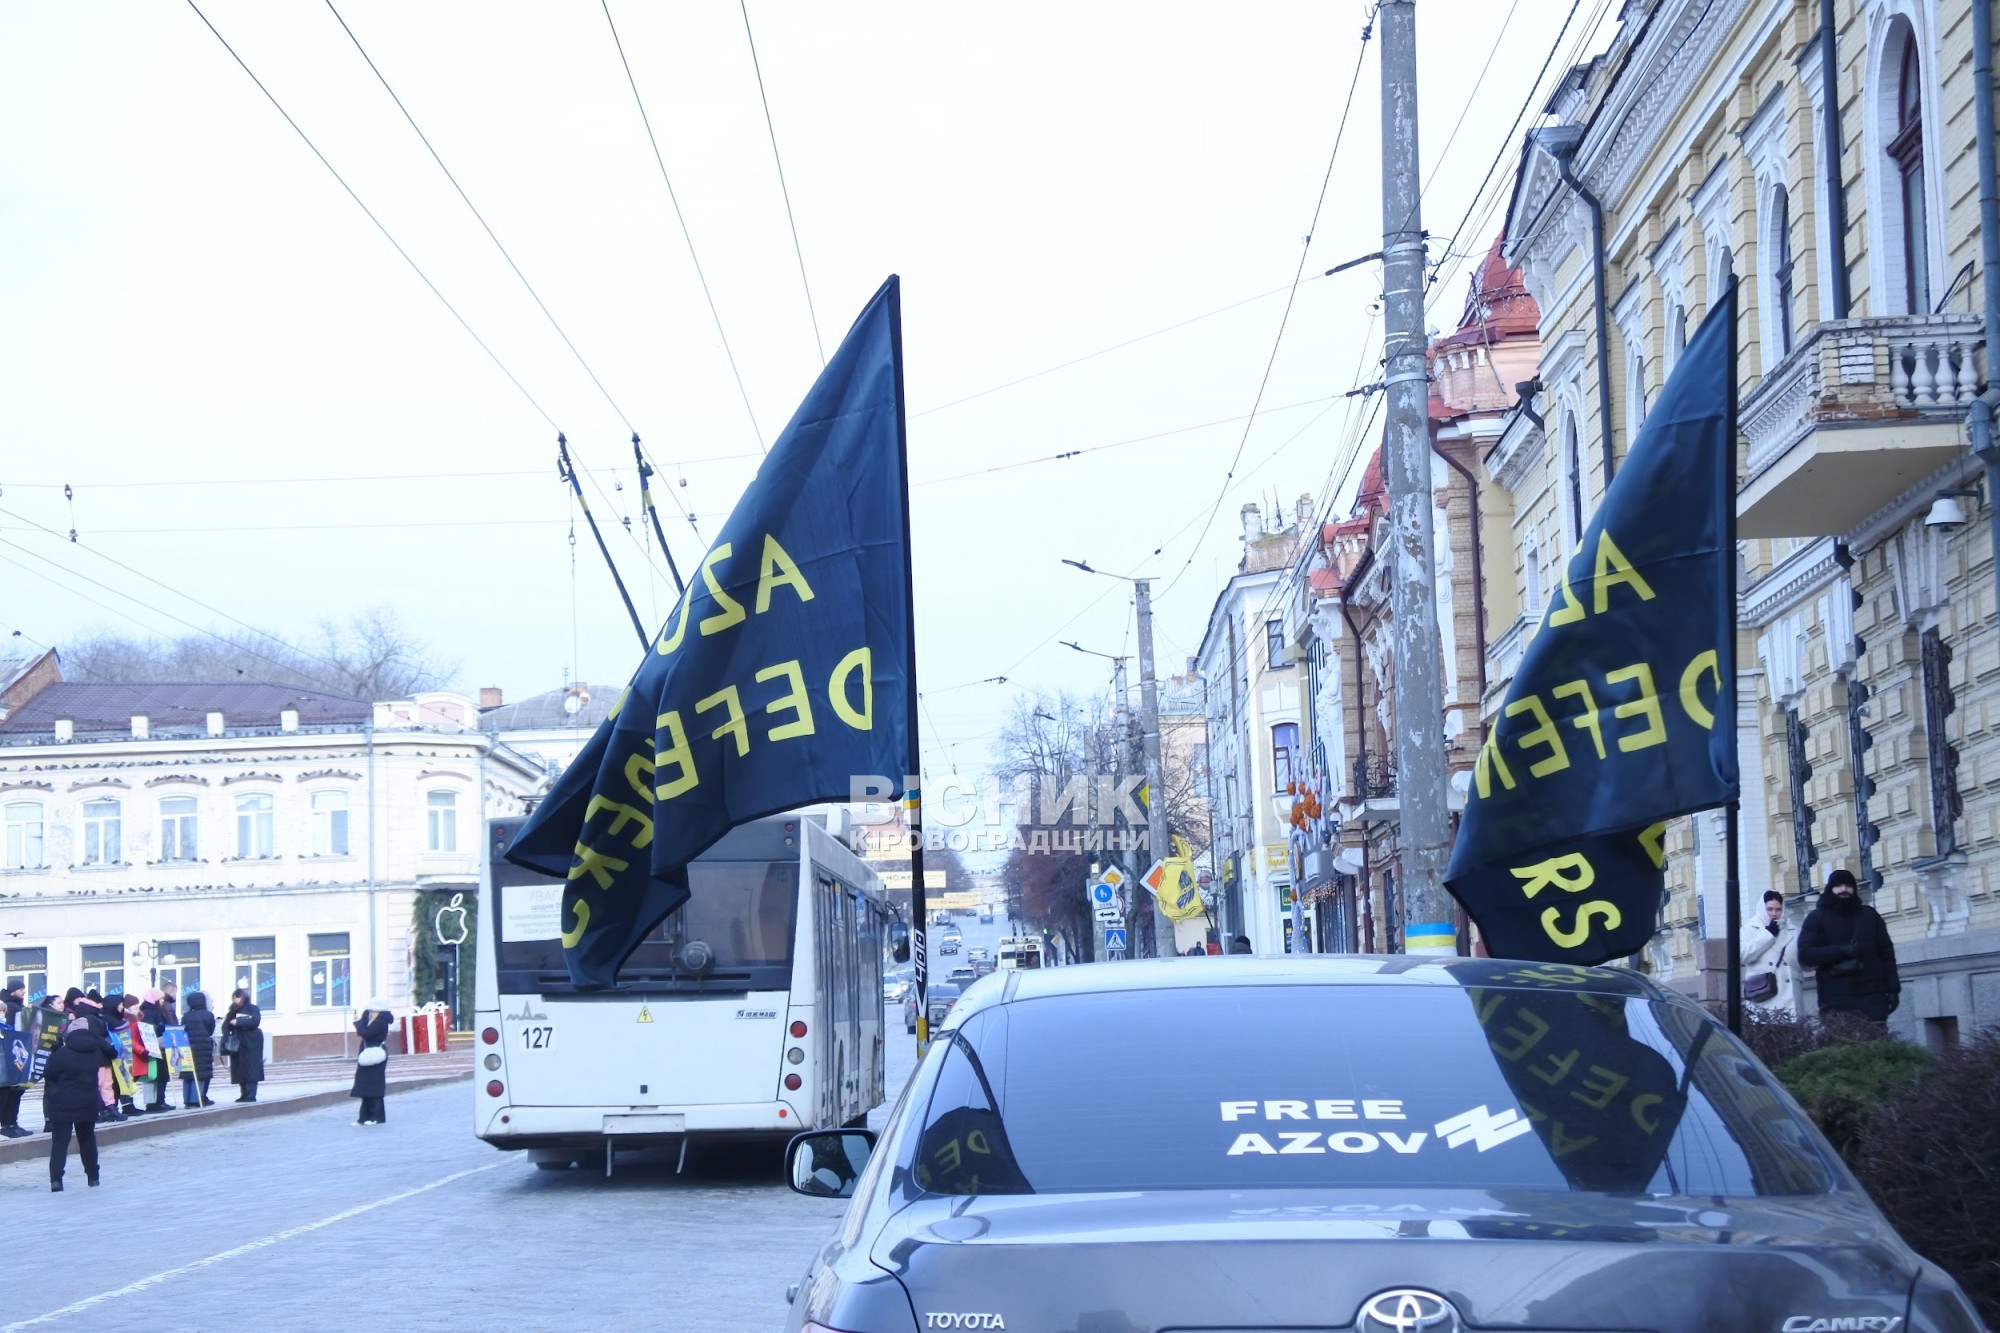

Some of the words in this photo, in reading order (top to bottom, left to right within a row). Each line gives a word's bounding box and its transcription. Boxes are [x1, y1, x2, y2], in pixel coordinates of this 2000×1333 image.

[915, 929, 926, 983] 400
[522, 1027, 553, 1050] 127
[1220, 1100, 1407, 1121] FREE
[1227, 1132, 1428, 1155] AZOV
[926, 1312, 1006, 1329] TOYOTA
[1782, 1315, 1903, 1333] CAMRY
